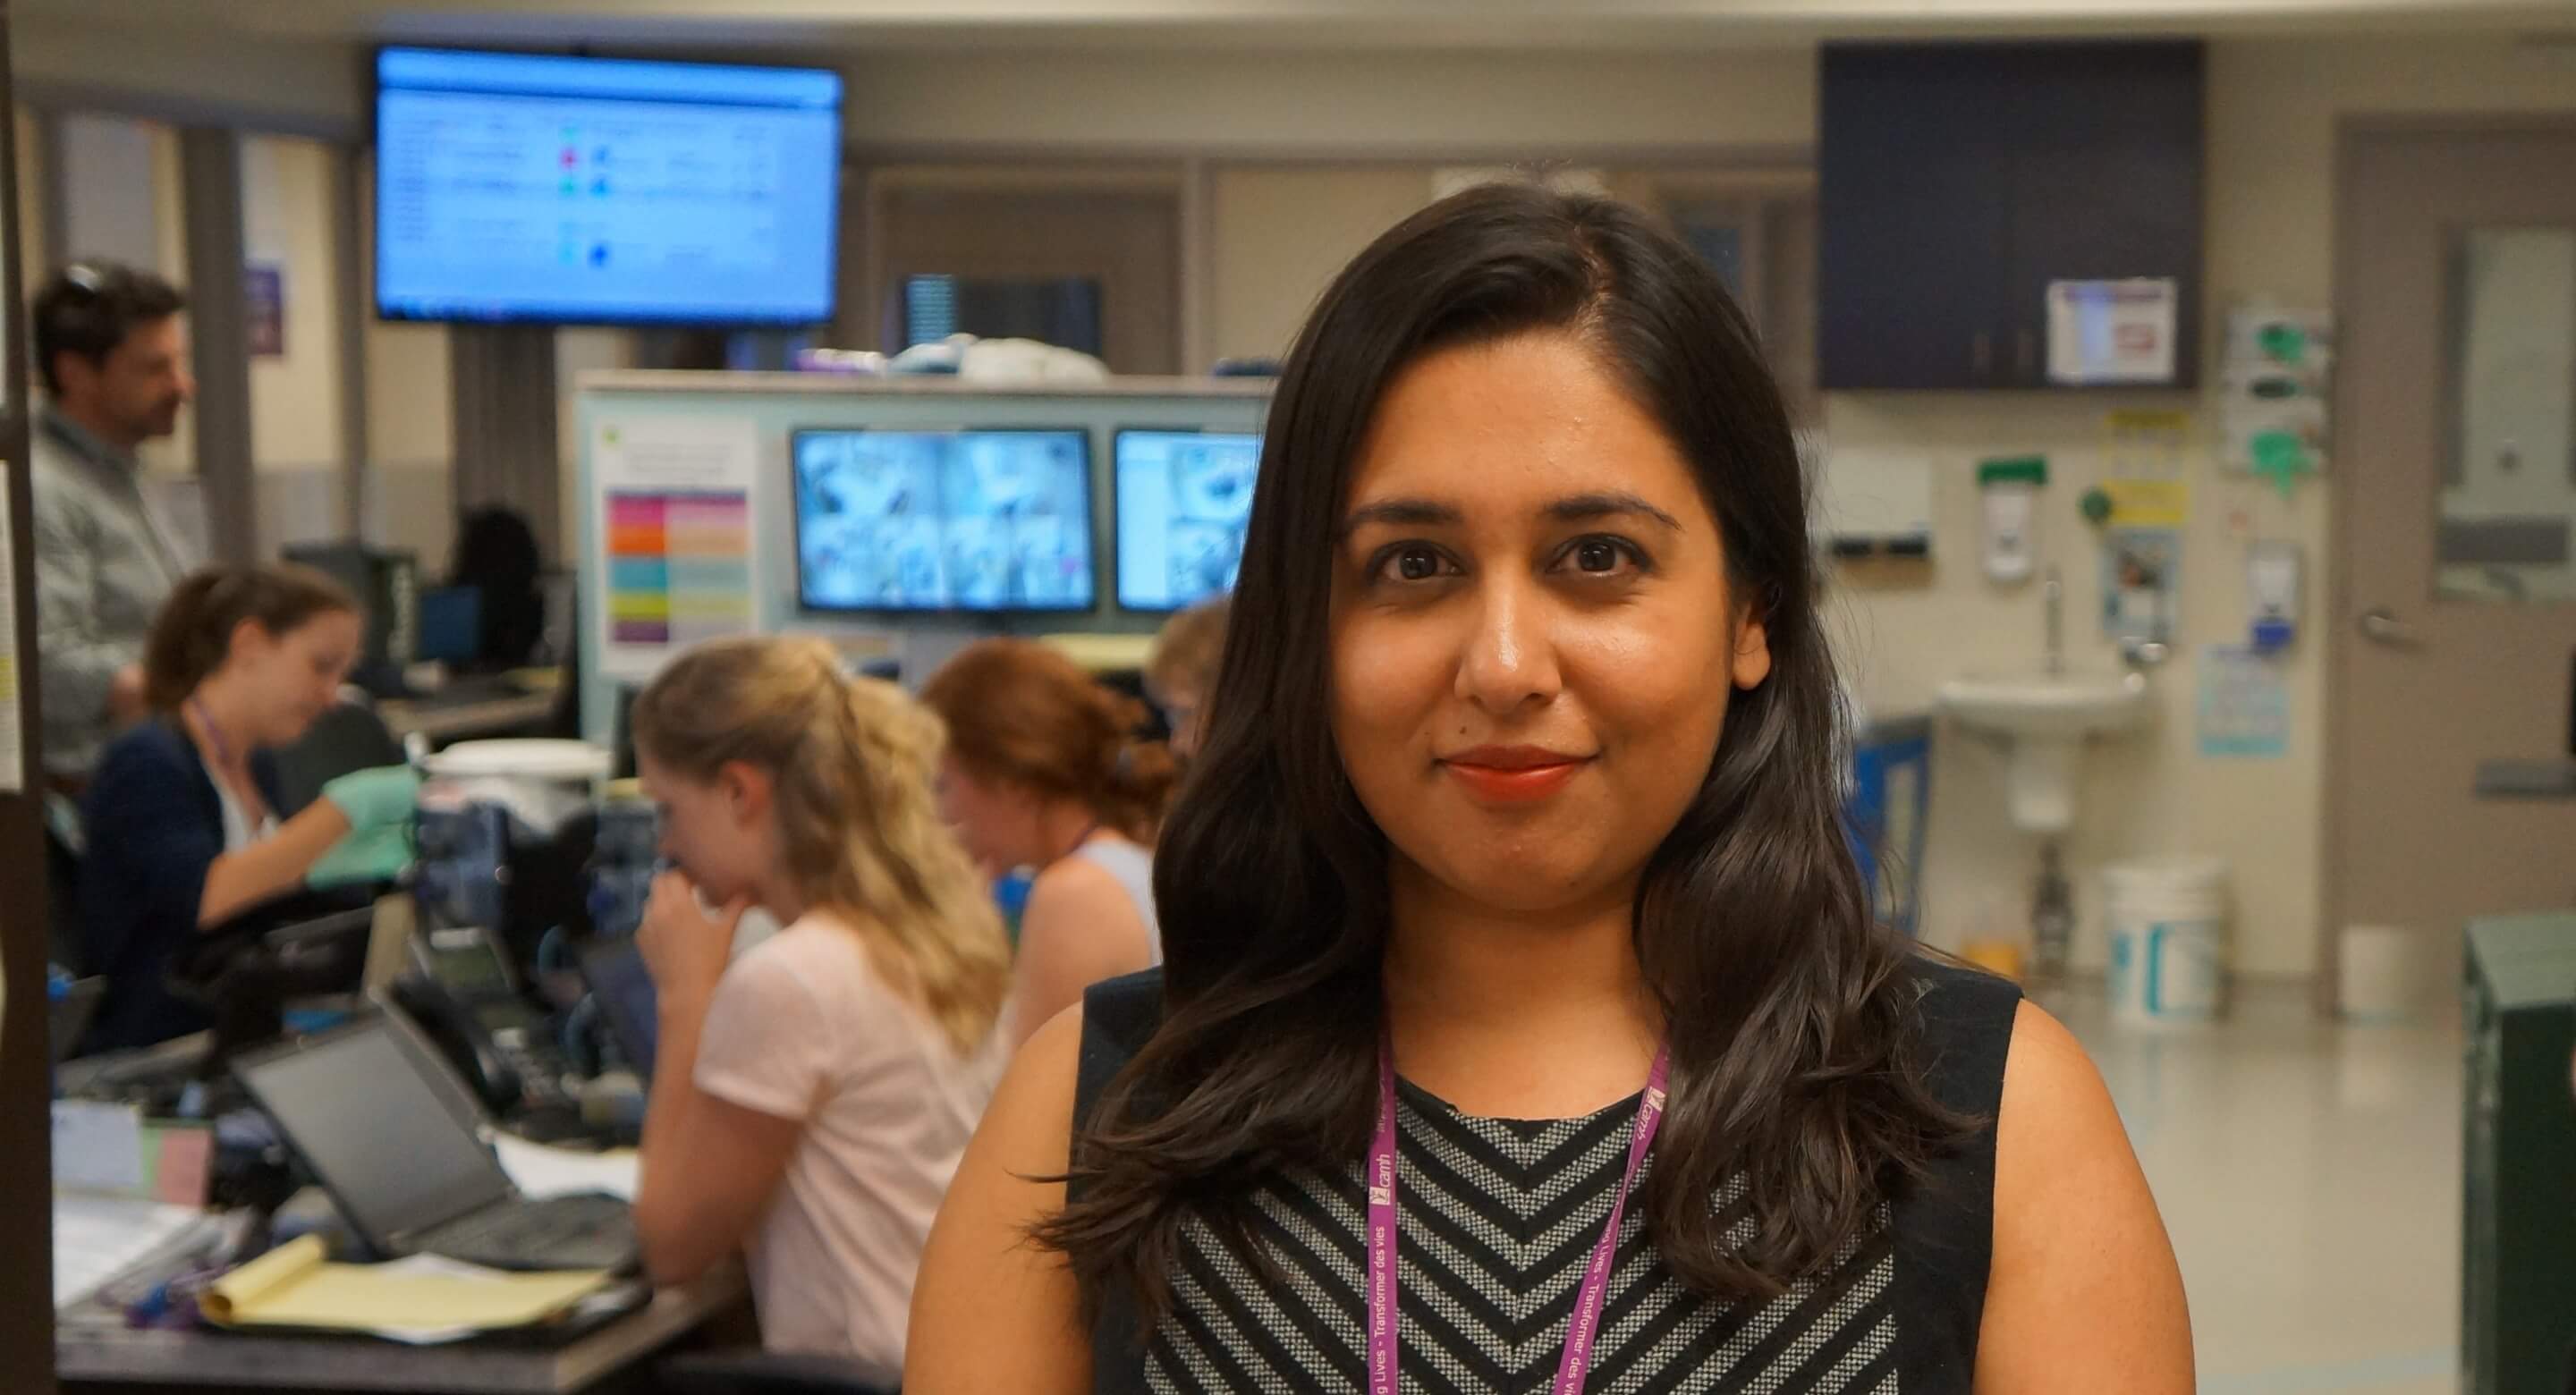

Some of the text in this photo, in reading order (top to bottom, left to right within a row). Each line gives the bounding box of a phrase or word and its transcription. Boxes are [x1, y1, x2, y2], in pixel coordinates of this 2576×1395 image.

[1376, 1154, 1391, 1188] camh
[1374, 1226, 1385, 1247] vies
[1374, 1249, 1385, 1268] des
[1593, 1245, 1609, 1272] Lives
[1374, 1271, 1386, 1338] Transformer
[1573, 1284, 1600, 1355] Transformer
[1375, 1349, 1386, 1382] Lives
[1567, 1357, 1581, 1379] des
